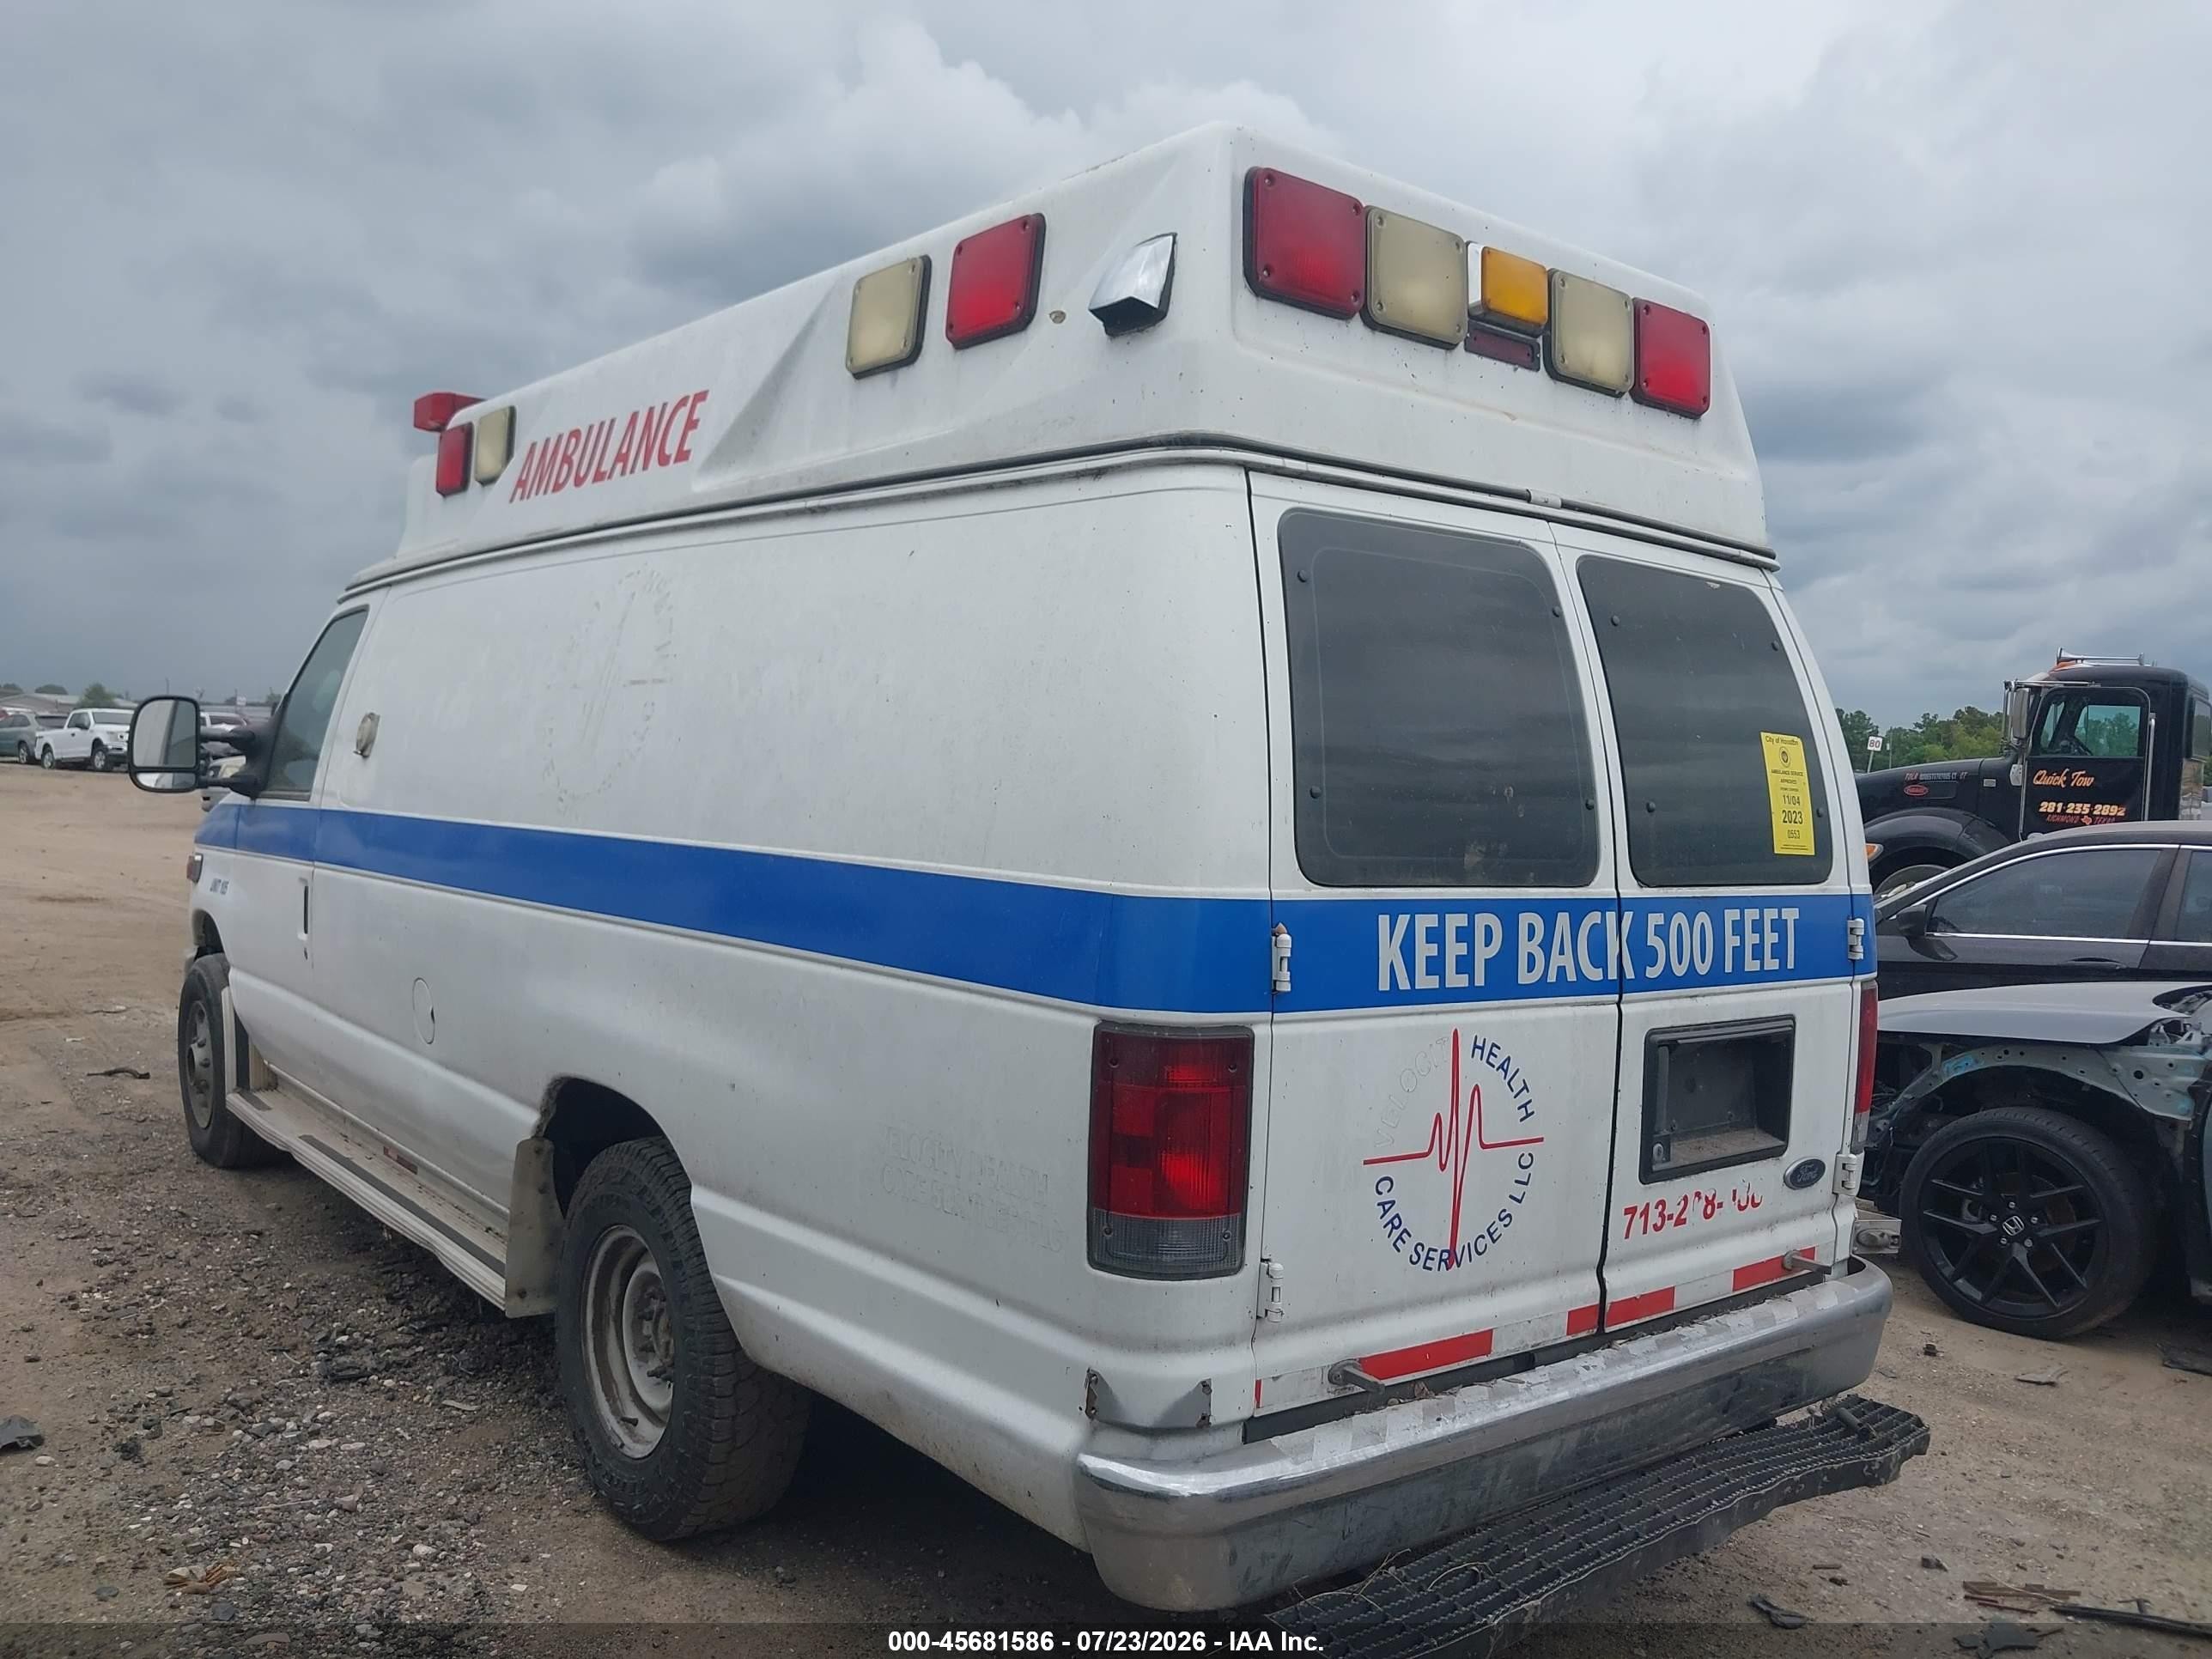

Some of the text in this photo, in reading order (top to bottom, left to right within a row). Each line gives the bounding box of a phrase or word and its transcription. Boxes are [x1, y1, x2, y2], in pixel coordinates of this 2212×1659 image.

[509, 390, 709, 504] AMBULANCE
[1869, 739, 1881, 749] 80
[2033, 768, 2095, 788] Quick Tow
[1782, 810, 1803, 824] 2023
[1377, 908, 1801, 992] KEEP BACK 500 FEET
[1471, 1035, 1535, 1122] HEALTH
[1375, 1152, 1534, 1272] CARE SERVICES LLC
